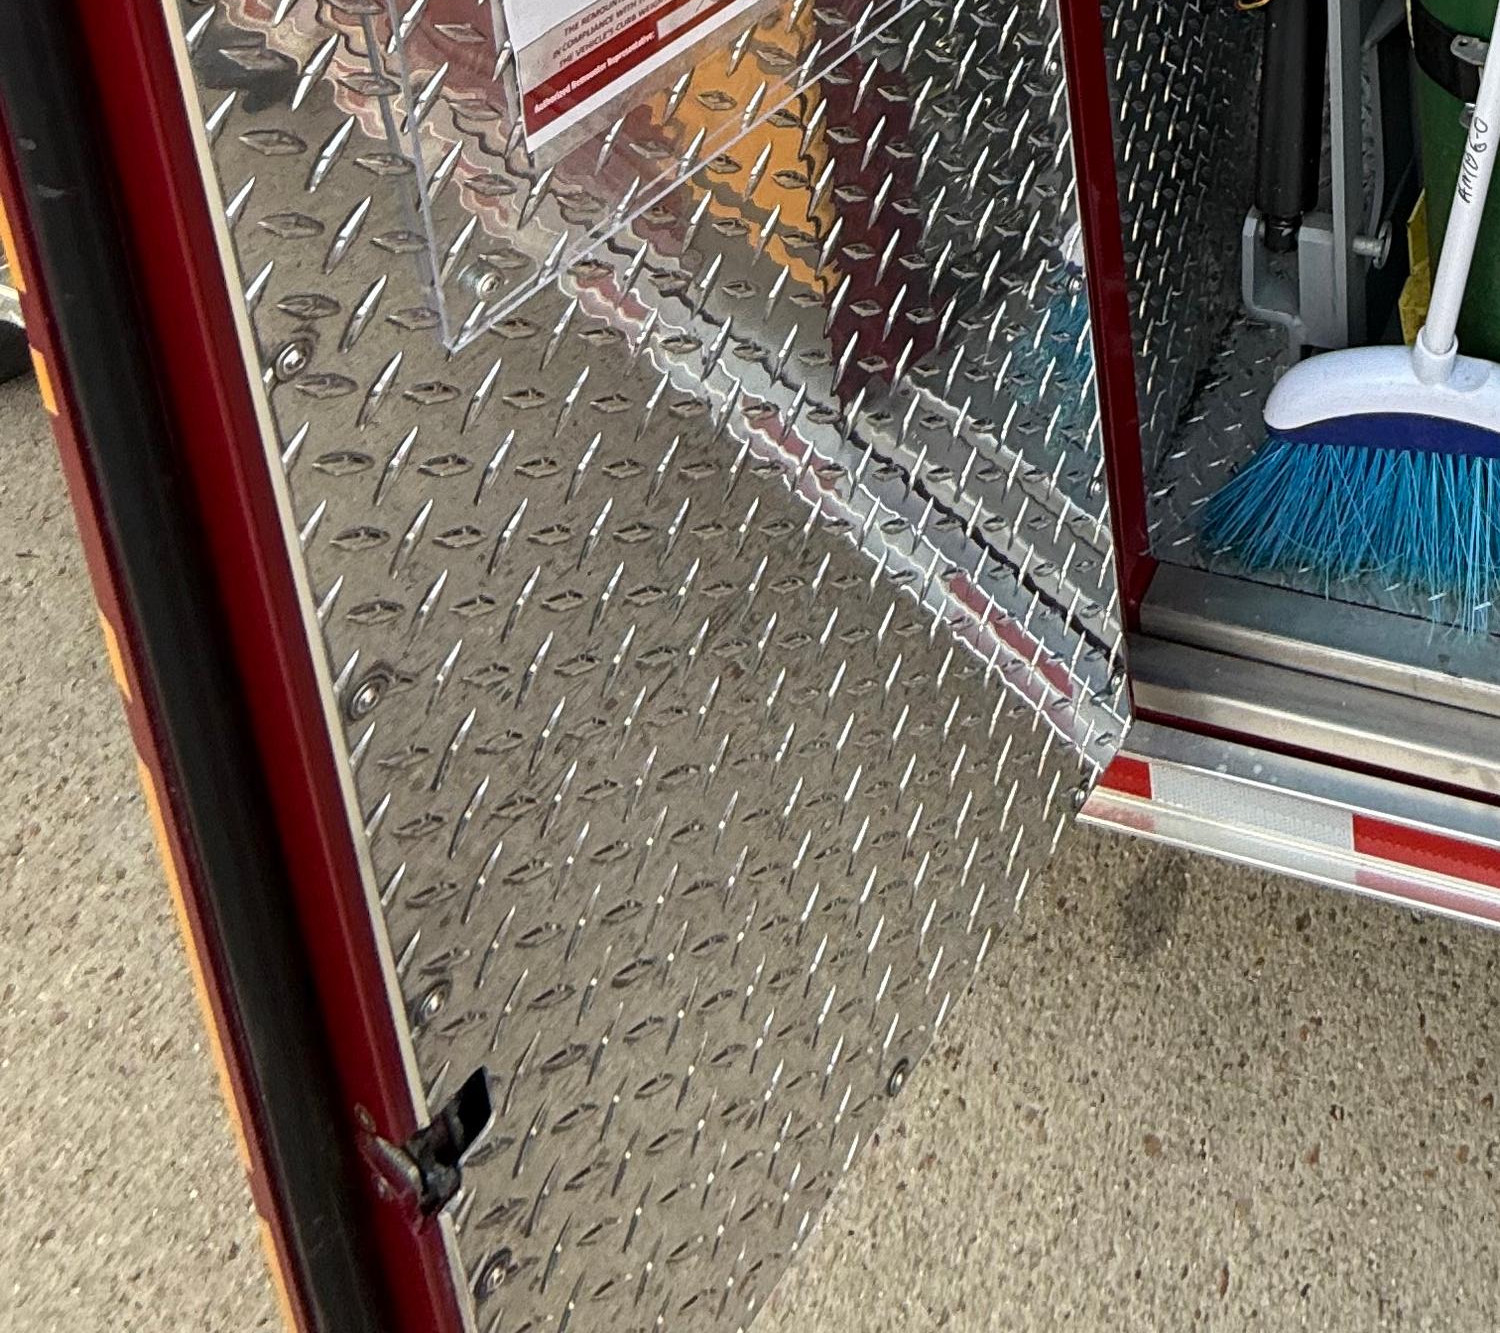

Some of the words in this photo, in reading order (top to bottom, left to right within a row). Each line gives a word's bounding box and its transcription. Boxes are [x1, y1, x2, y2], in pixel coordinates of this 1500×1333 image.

[561, 12, 614, 53] COMPLIANCE
[563, 20, 580, 38] THE
[614, 11, 637, 33] CURB
